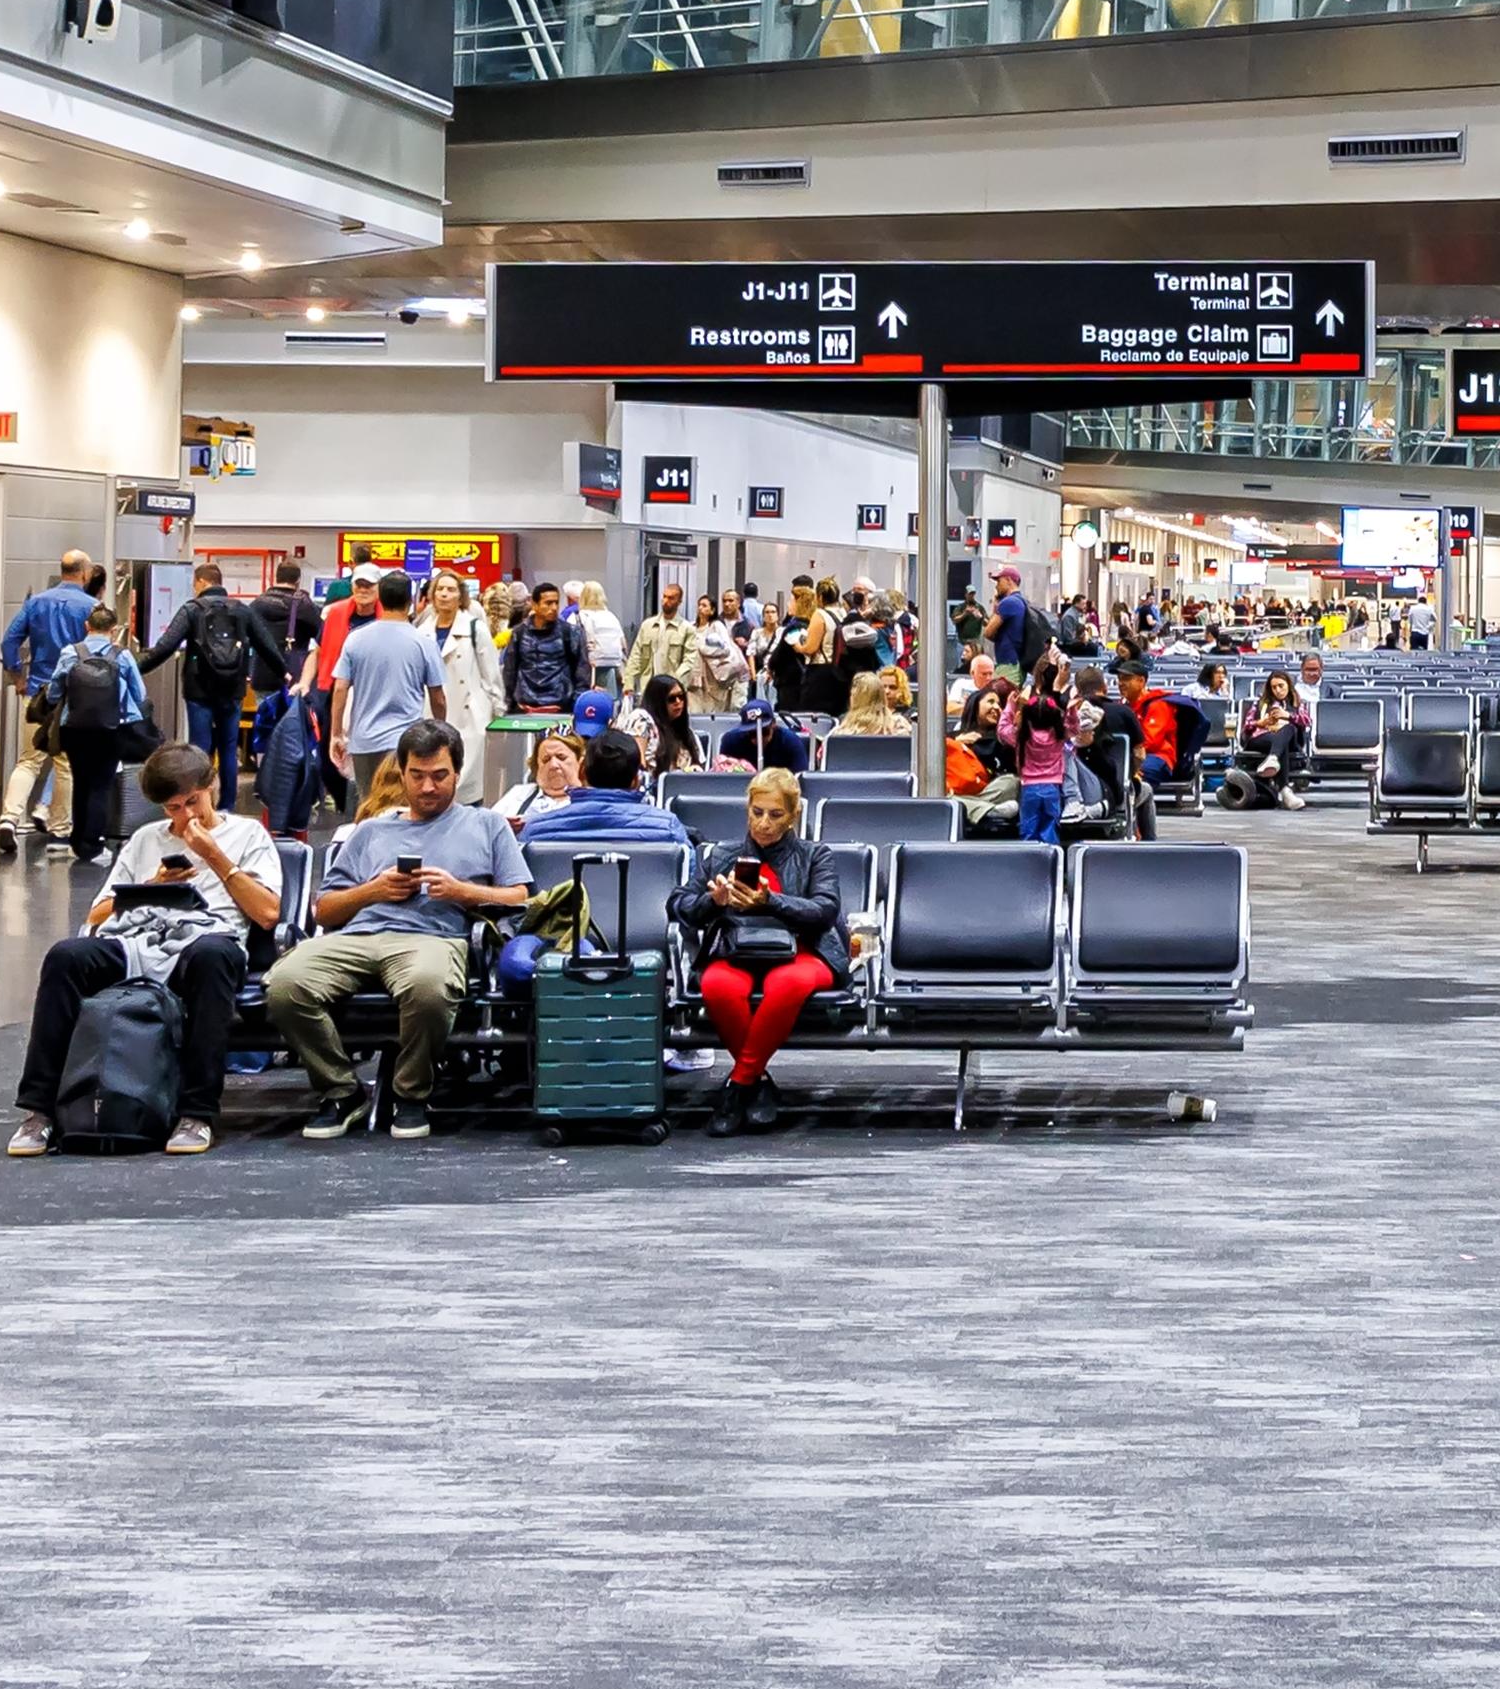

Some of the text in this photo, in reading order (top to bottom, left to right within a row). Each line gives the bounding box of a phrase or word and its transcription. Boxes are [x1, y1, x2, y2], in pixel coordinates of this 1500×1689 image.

[741, 281, 809, 301] J1-J11
[1154, 272, 1250, 291] Terminal
[1190, 296, 1250, 310] Terminal
[690, 327, 811, 346] Restrooms
[1082, 324, 1249, 347] Baggage Claim
[766, 350, 811, 364] Baños
[1100, 348, 1250, 364] Reclamo de Equipaje
[656, 468, 690, 487] J11
[1000, 525, 1014, 537] J9
